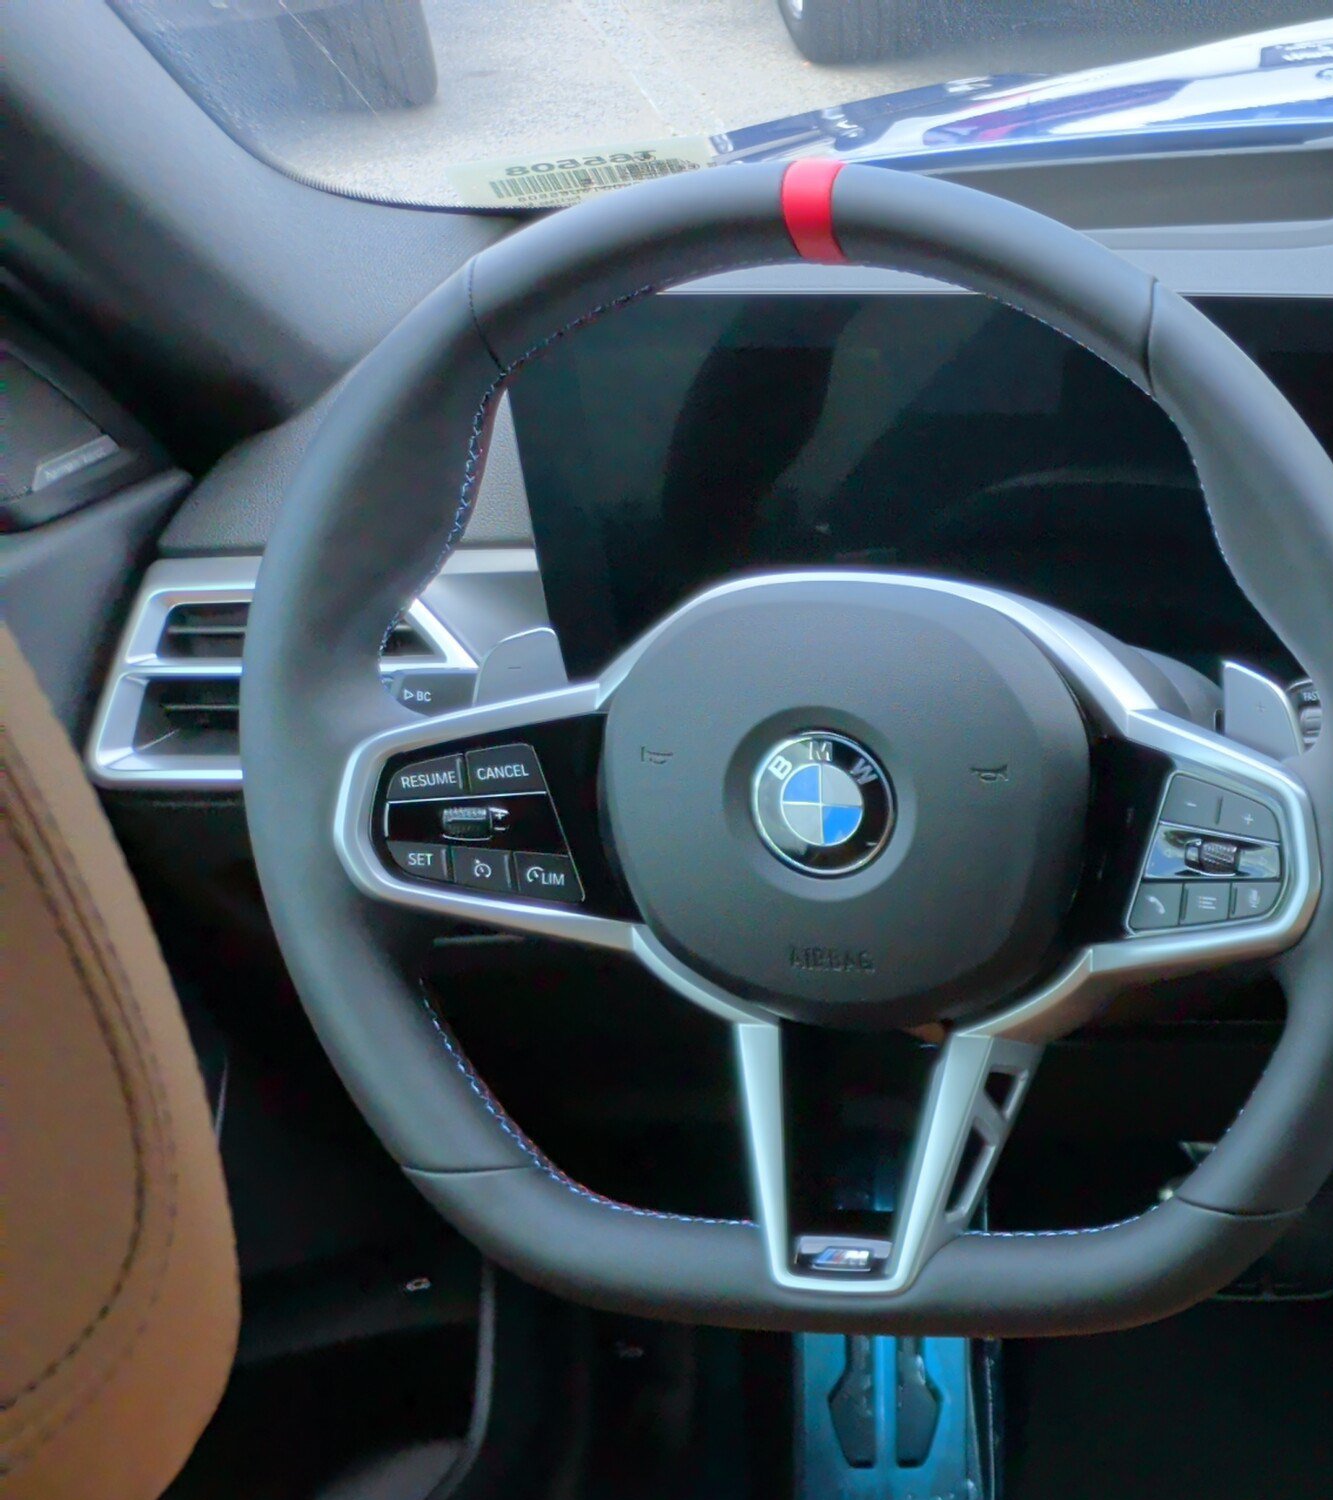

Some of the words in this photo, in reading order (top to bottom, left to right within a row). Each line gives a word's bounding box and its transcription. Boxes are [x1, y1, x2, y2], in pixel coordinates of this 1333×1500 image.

[416, 690, 432, 702] BC
[768, 741, 879, 785] BMW
[401, 770, 457, 789] RESUME
[476, 763, 530, 781] CANCEL
[408, 852, 433, 867] SET
[541, 871, 565, 886] LIM
